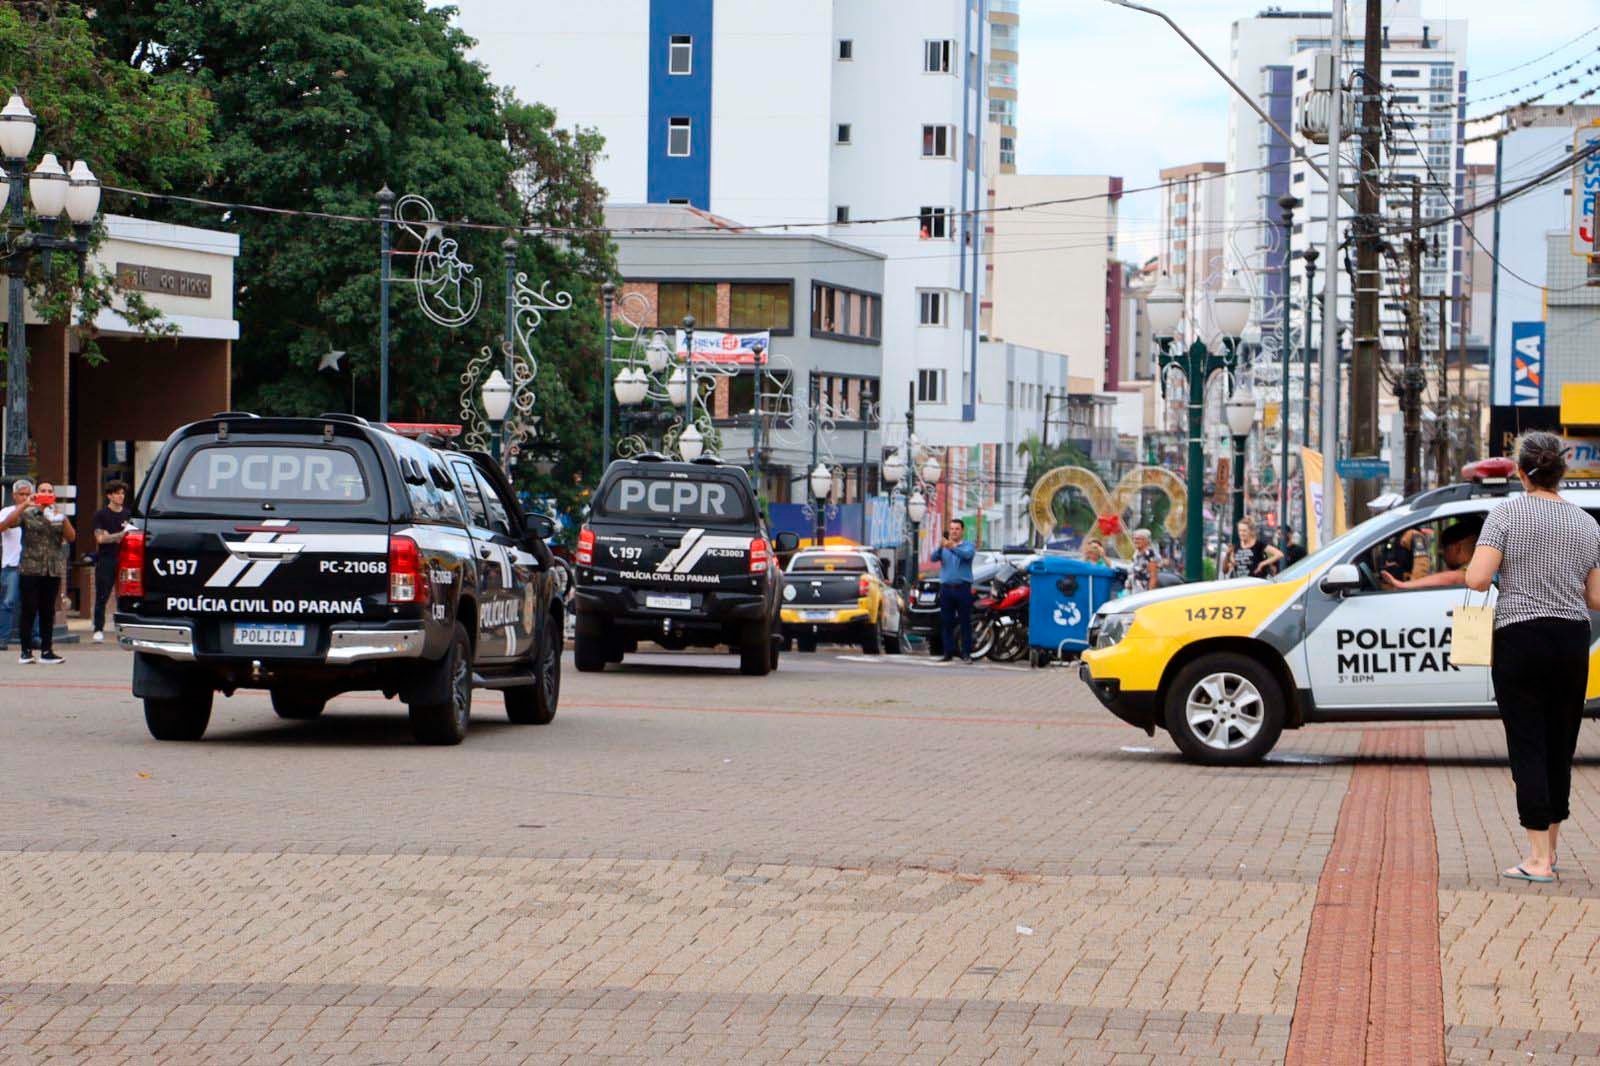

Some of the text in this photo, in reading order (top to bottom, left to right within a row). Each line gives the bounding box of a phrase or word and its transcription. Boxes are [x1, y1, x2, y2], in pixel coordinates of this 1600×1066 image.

[208, 454, 333, 491] PCPR
[619, 479, 726, 515] PCPR
[619, 547, 642, 559] 197
[167, 560, 198, 575] 197
[320, 560, 387, 574] PC-21068
[619, 570, 720, 584] POLÍCIA CIVIL DO PARANÁ
[166, 595, 364, 614] POLÍCIA CIVIL DO PARANÁ
[1185, 606, 1247, 621] 14787
